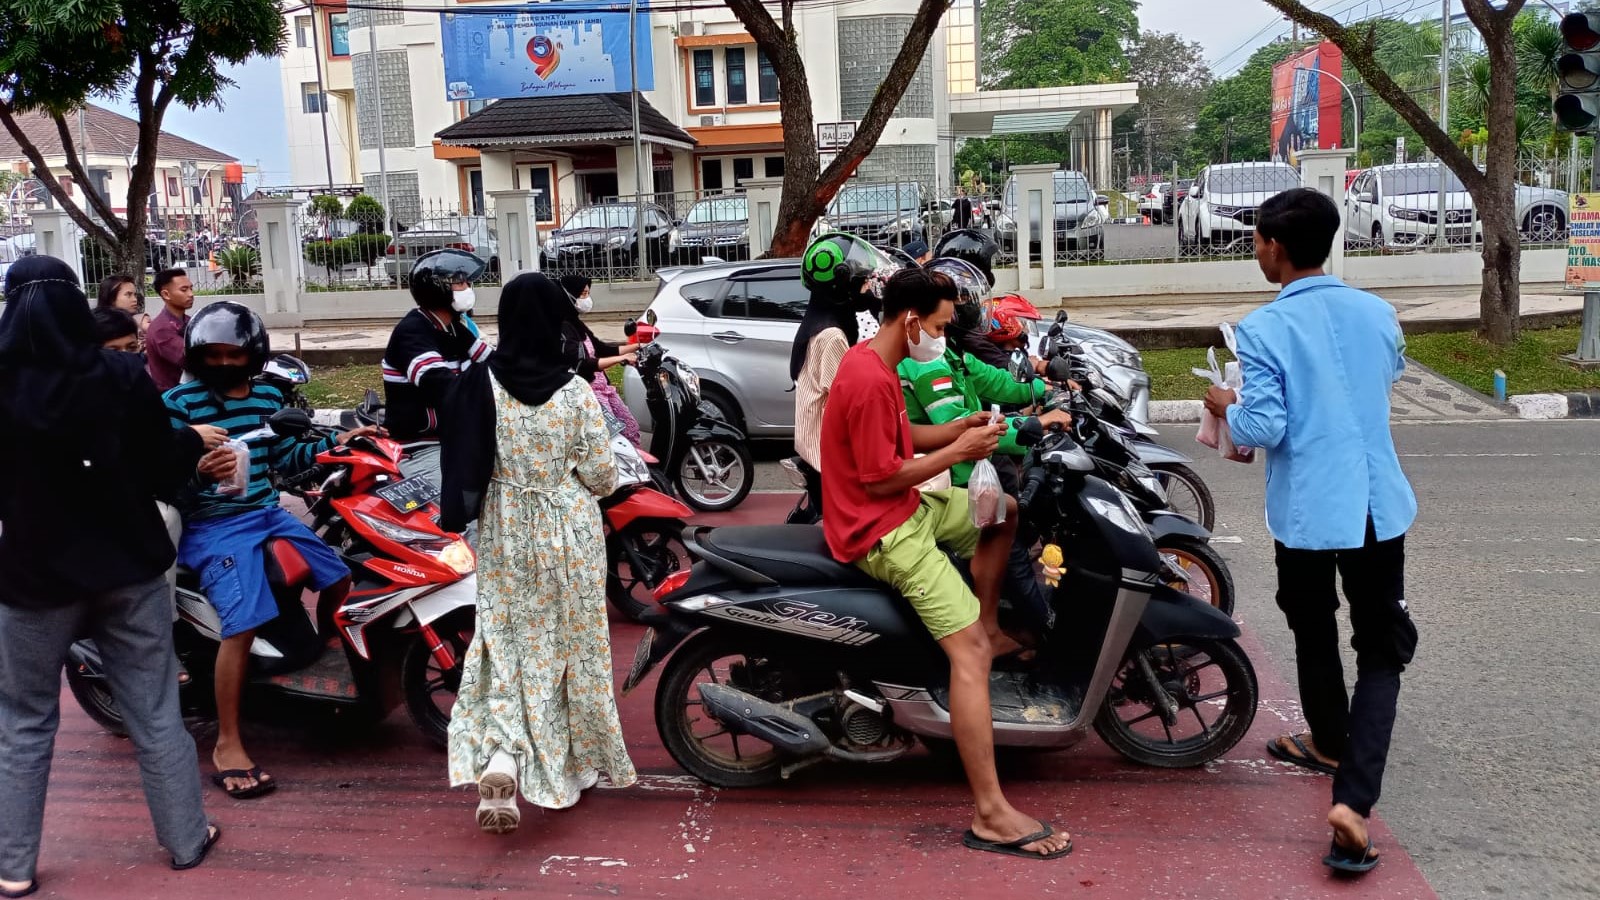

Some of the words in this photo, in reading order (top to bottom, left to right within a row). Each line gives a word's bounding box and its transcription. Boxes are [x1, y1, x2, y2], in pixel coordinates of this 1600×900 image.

[1568, 257, 1579, 266] KE
[393, 565, 426, 578] HONDA
[724, 607, 780, 624] Genio
